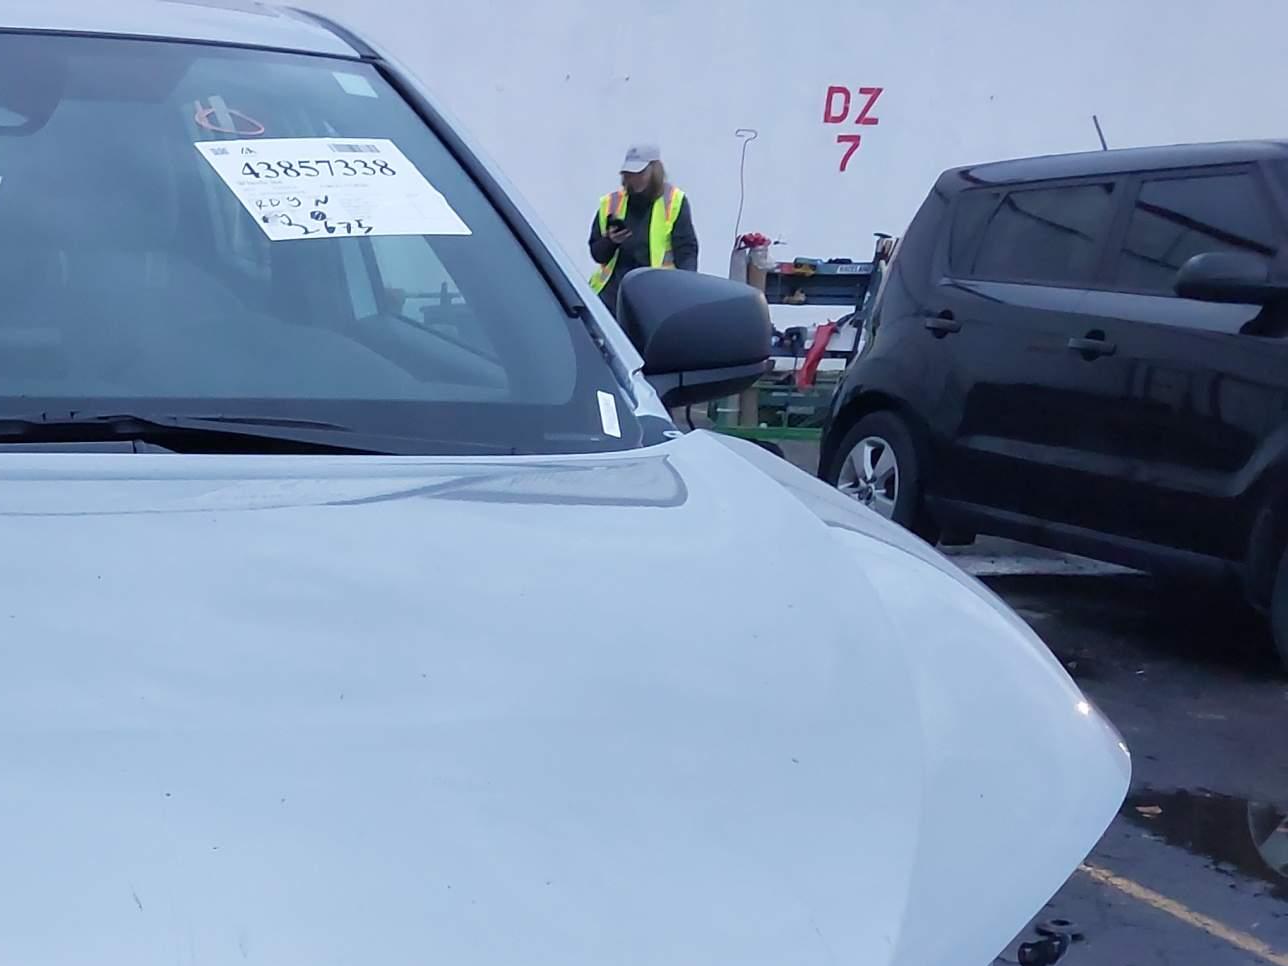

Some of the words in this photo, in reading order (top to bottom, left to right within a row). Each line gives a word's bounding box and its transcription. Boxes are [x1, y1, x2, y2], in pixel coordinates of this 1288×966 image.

[823, 86, 884, 125] DZ
[241, 159, 397, 179] 43857338
[837, 135, 861, 172] 7
